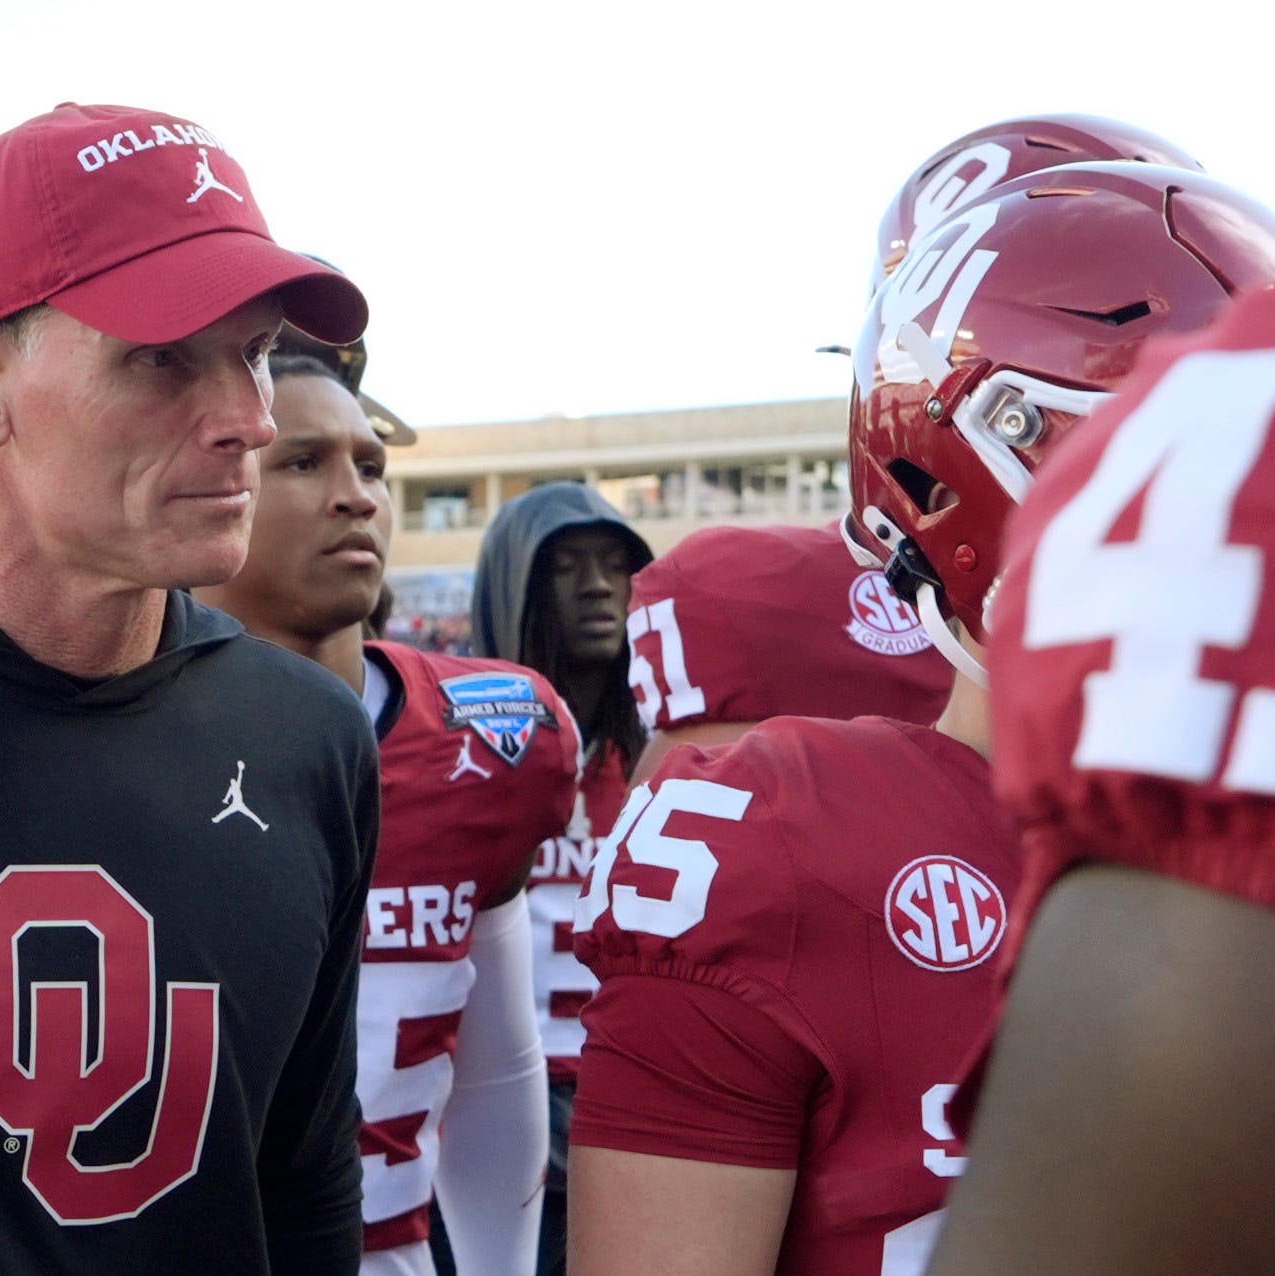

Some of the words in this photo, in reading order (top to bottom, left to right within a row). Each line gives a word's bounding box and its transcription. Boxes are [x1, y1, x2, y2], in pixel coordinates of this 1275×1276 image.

[76, 123, 232, 172] OKLAHO
[856, 575, 919, 631] SE
[862, 633, 929, 653] GRADUA
[894, 860, 998, 964] SEC
